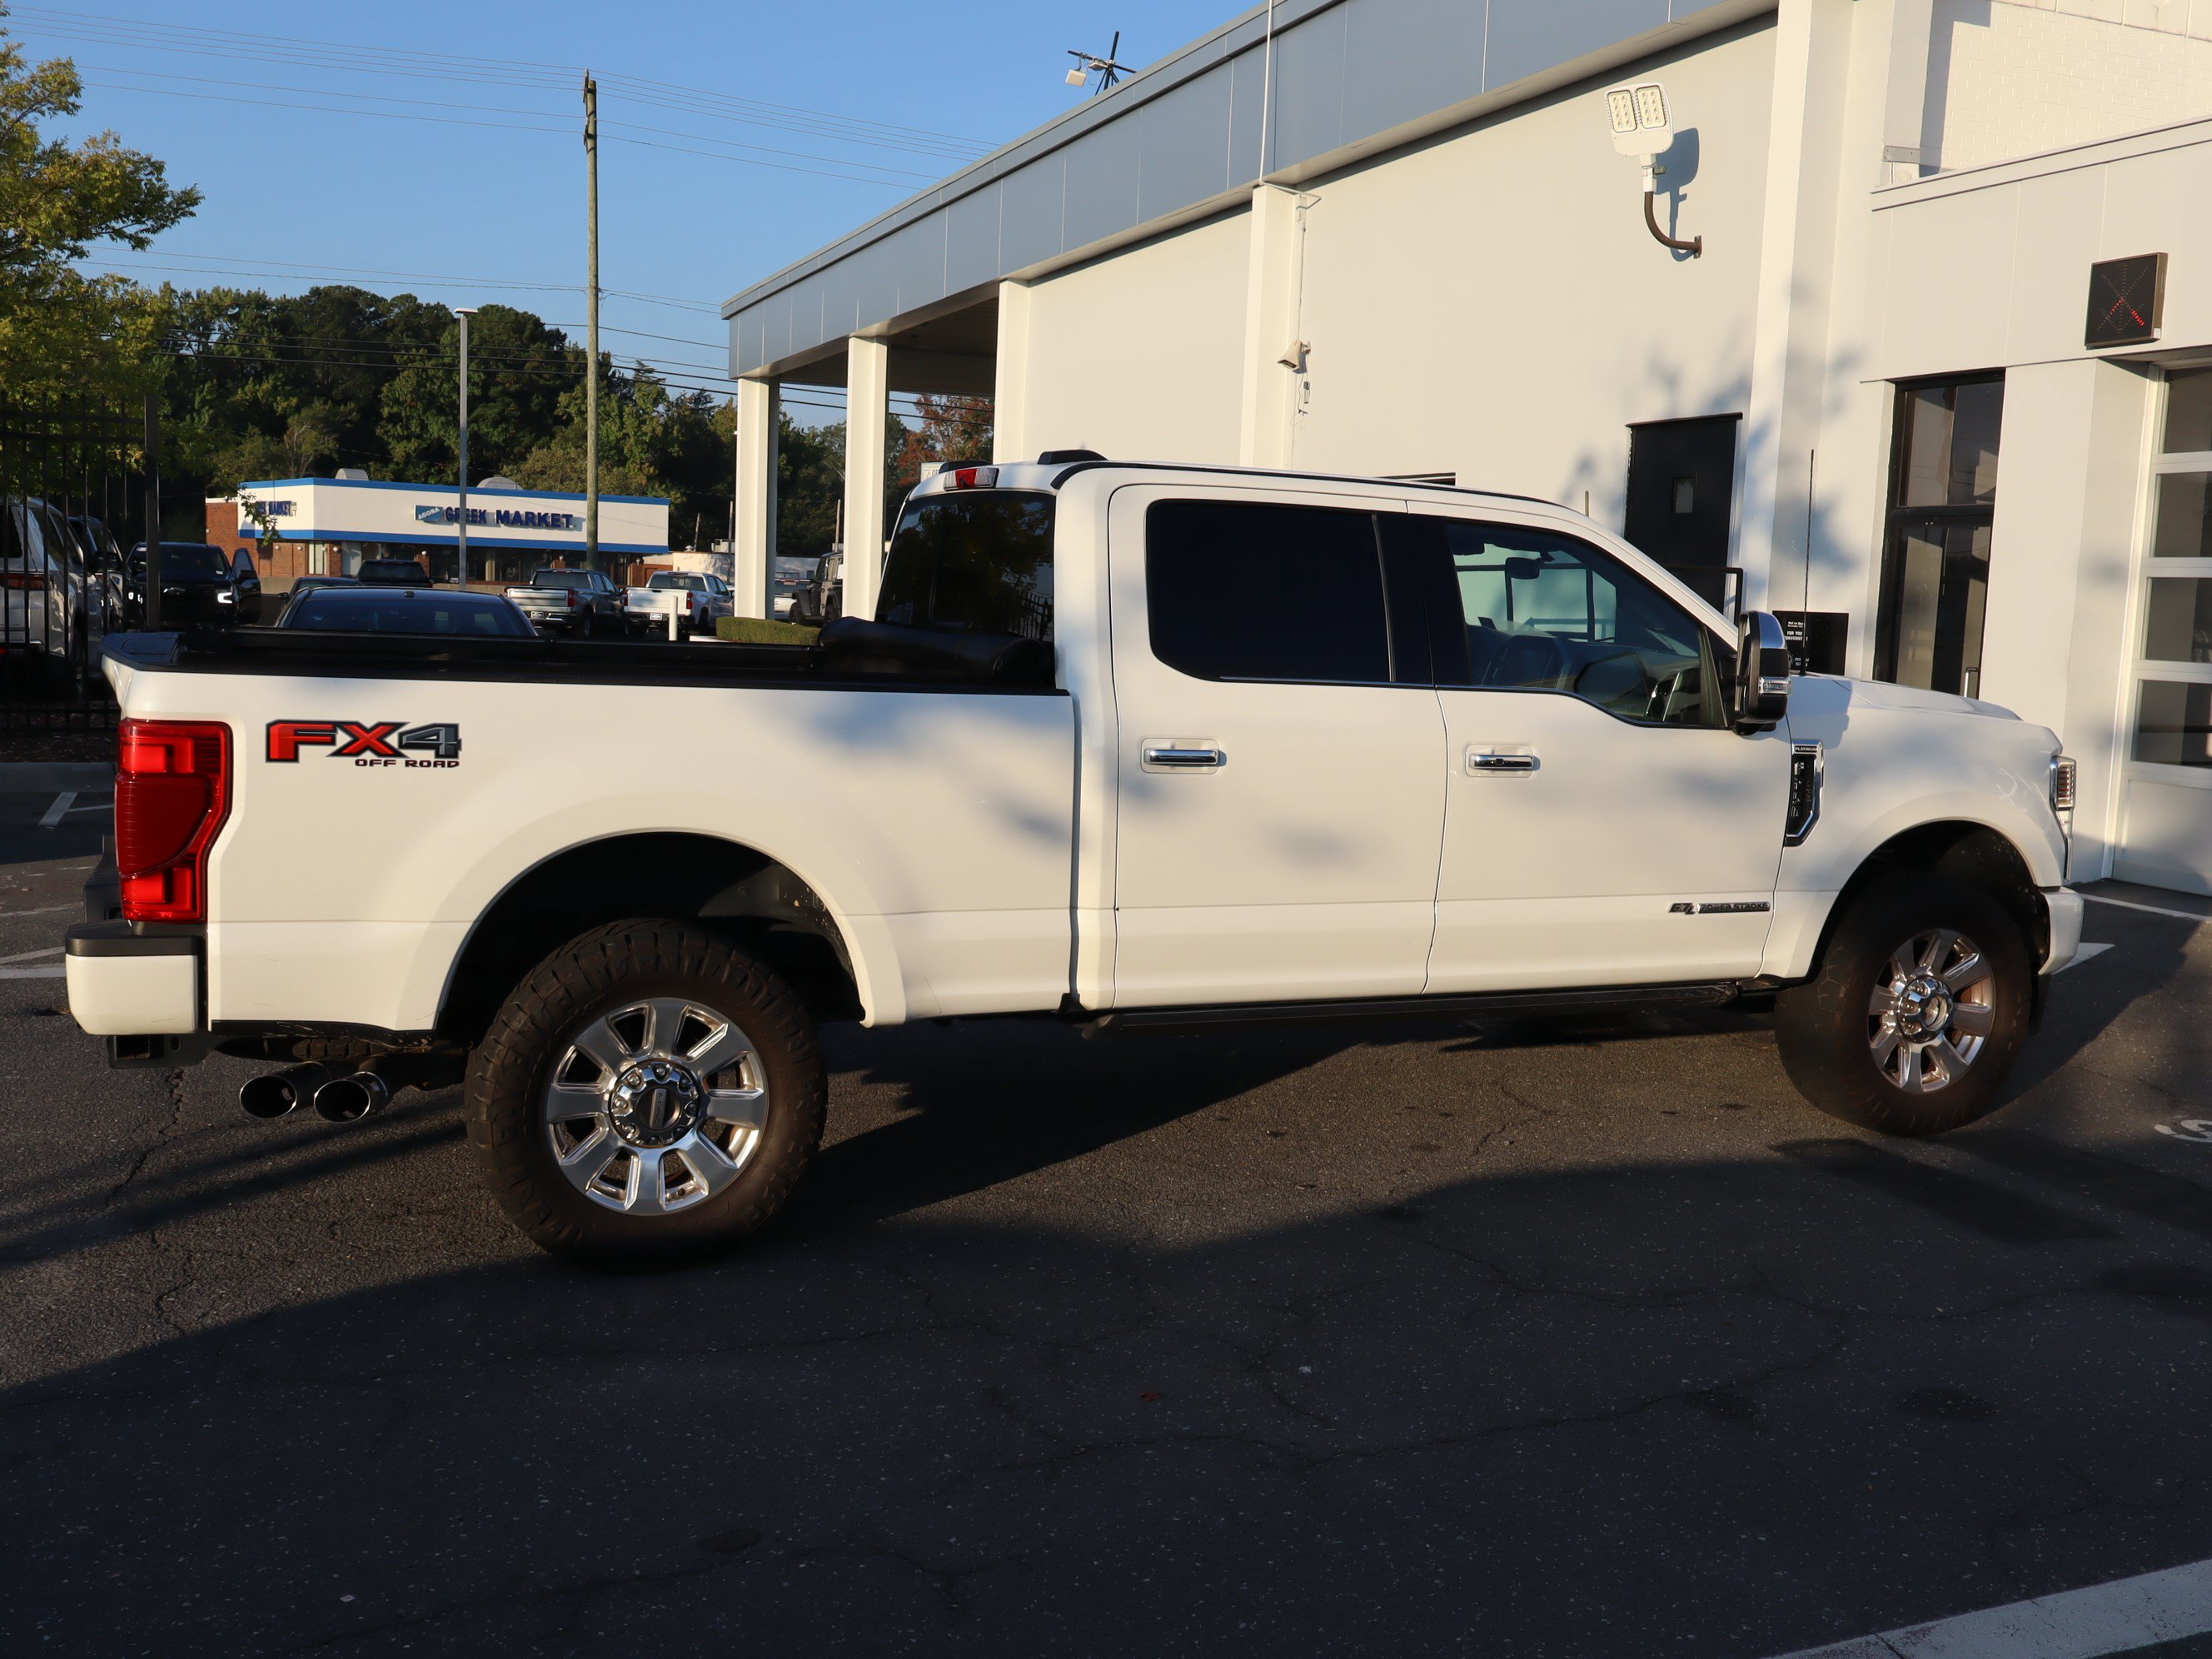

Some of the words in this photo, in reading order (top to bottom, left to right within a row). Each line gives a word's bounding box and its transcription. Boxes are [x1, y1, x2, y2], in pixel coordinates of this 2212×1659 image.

[417, 506, 441, 521] AGORA
[495, 509, 574, 528] MARKET
[265, 719, 462, 763] FX4
[355, 759, 396, 767] OFF
[405, 759, 460, 768] ROAD
[1701, 903, 1731, 912] POWER
[1732, 902, 1768, 911] STROKE
